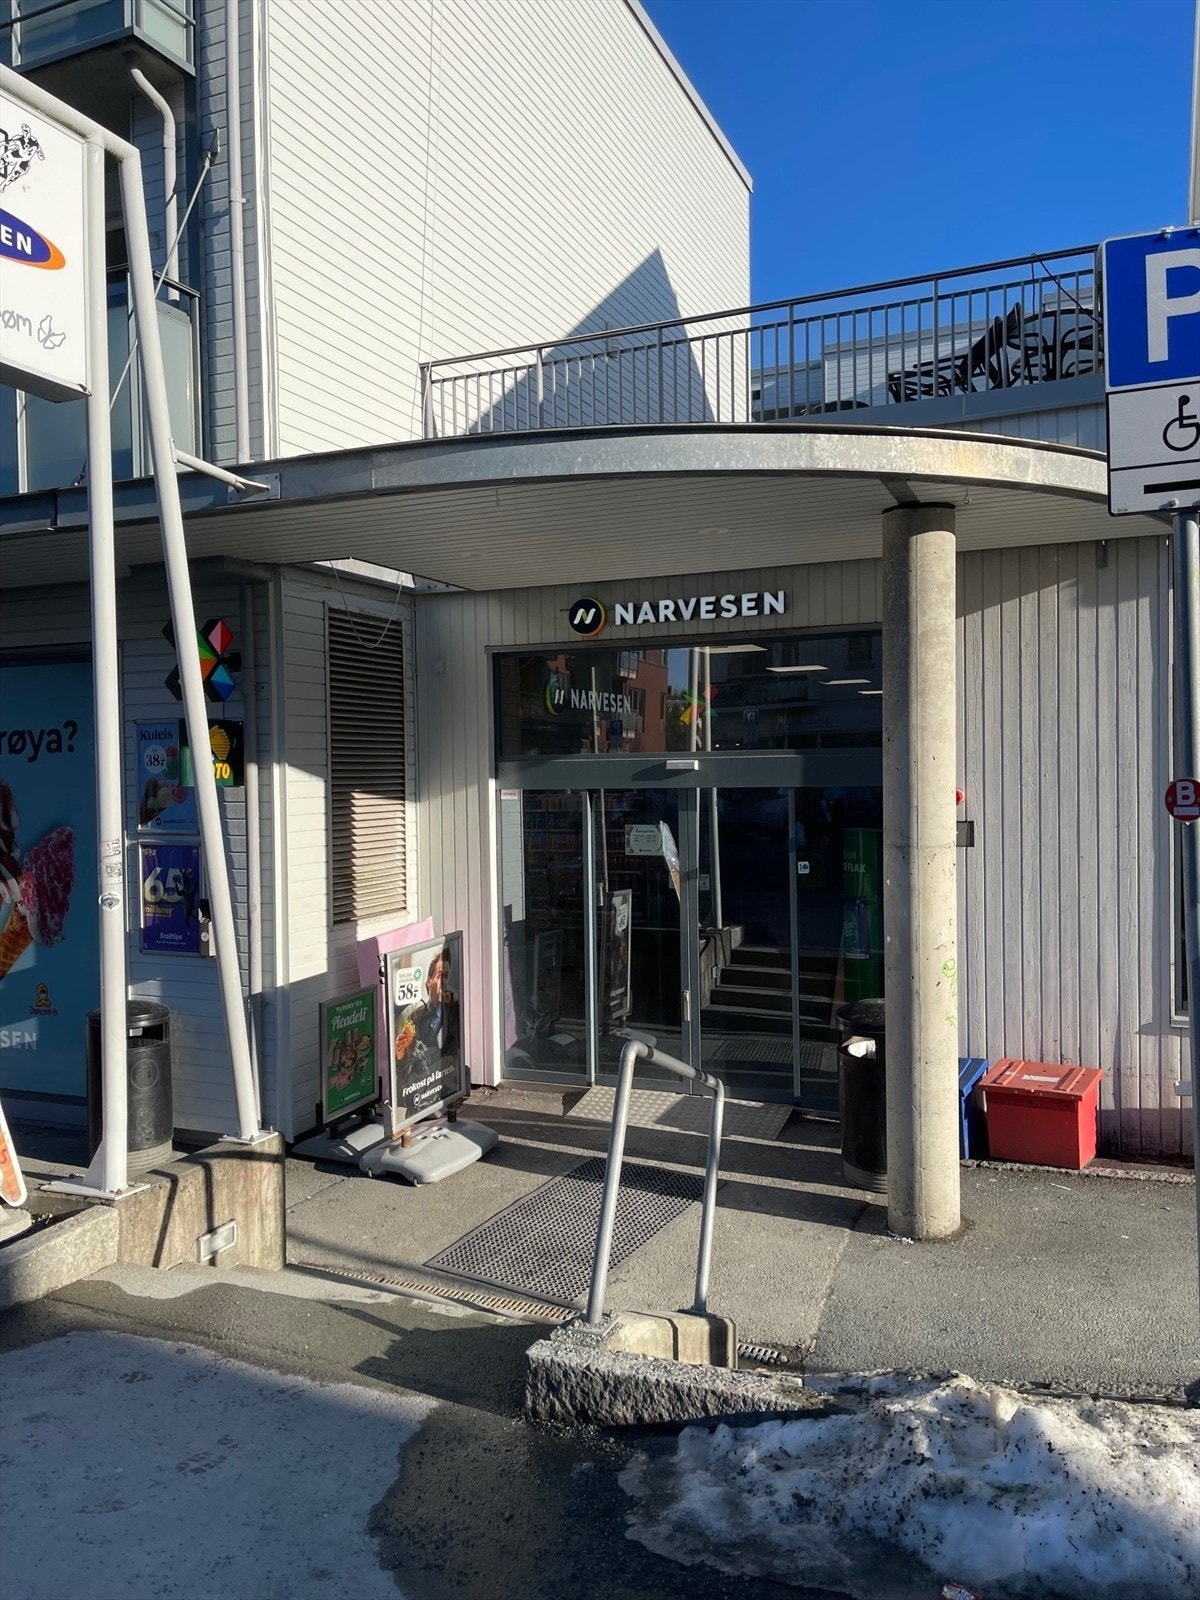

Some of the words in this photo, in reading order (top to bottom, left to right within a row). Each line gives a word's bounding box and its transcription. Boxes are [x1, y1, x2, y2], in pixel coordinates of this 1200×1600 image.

[1145, 247, 1200, 363] P
[614, 591, 786, 626] NARVESEN
[570, 687, 632, 714] NARVESEN
[1176, 781, 1196, 806] B
[331, 1007, 366, 1031] Picadeli
[402, 1078, 427, 1097] Frokost
[427, 1072, 436, 1086] på
